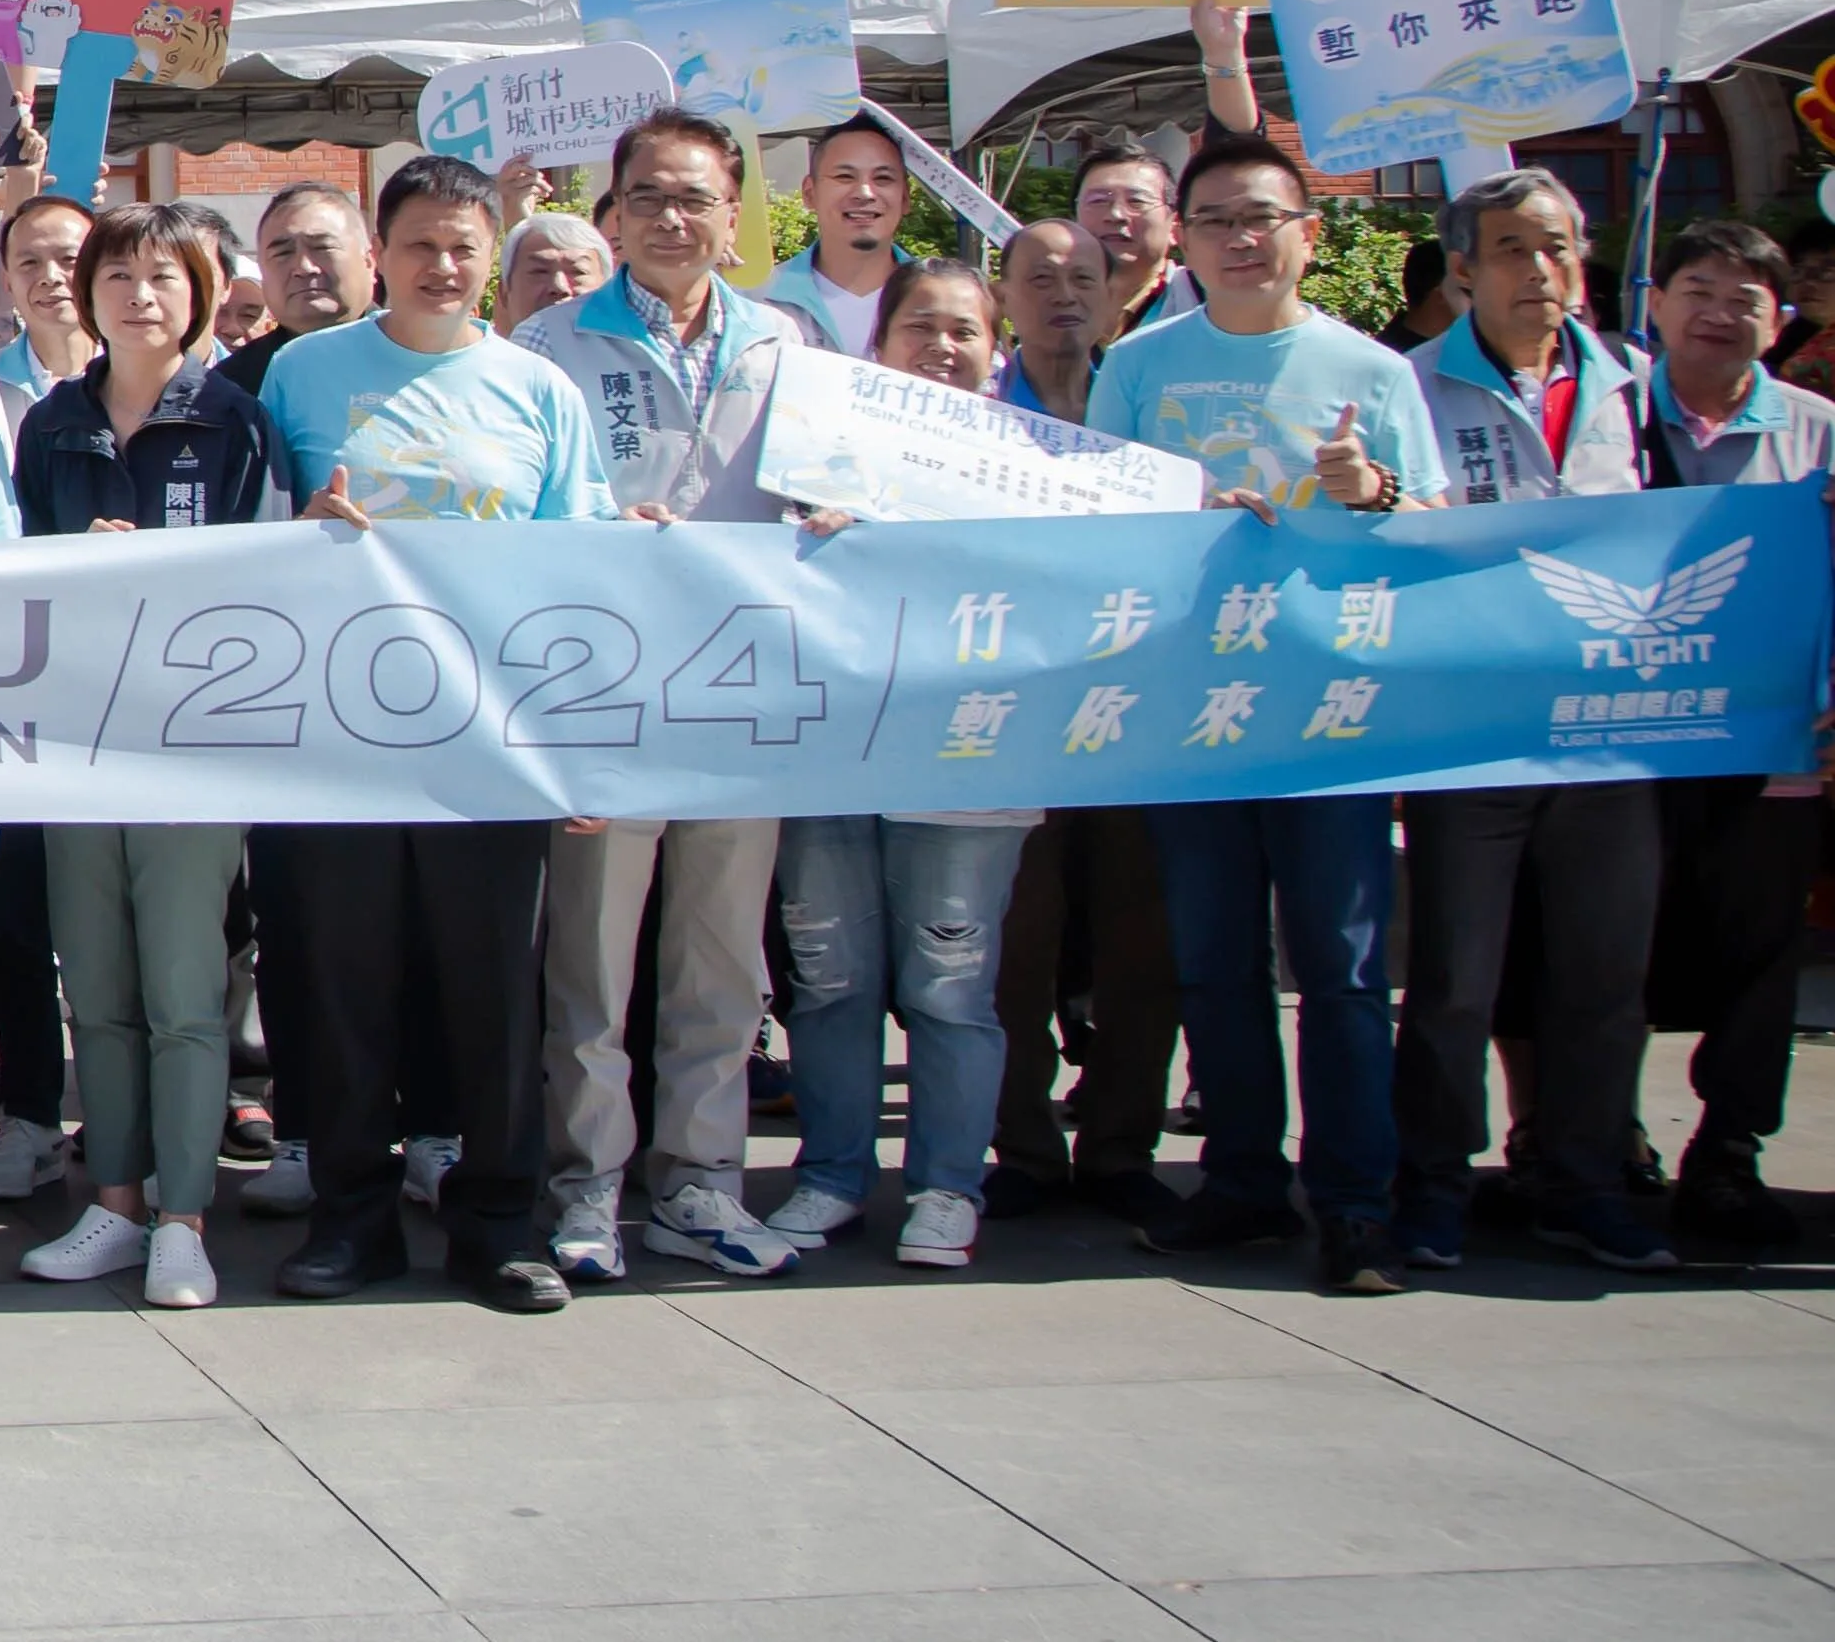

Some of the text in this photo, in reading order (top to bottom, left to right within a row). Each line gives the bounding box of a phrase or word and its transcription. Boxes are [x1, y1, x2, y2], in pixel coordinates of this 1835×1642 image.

[512, 143, 551, 157] HSIN
[554, 138, 589, 151] CHU
[601, 371, 642, 461] 陳文榮
[851, 402, 953, 440] HSIN CHU
[901, 452, 946, 471] 11.17
[1096, 475, 1154, 501] 2024
[947, 576, 1399, 663] 竹步較勁
[1579, 634, 1717, 671] FLIGHT
[160, 602, 828, 749] 2024
[936, 675, 1383, 760] 塹你來跑
